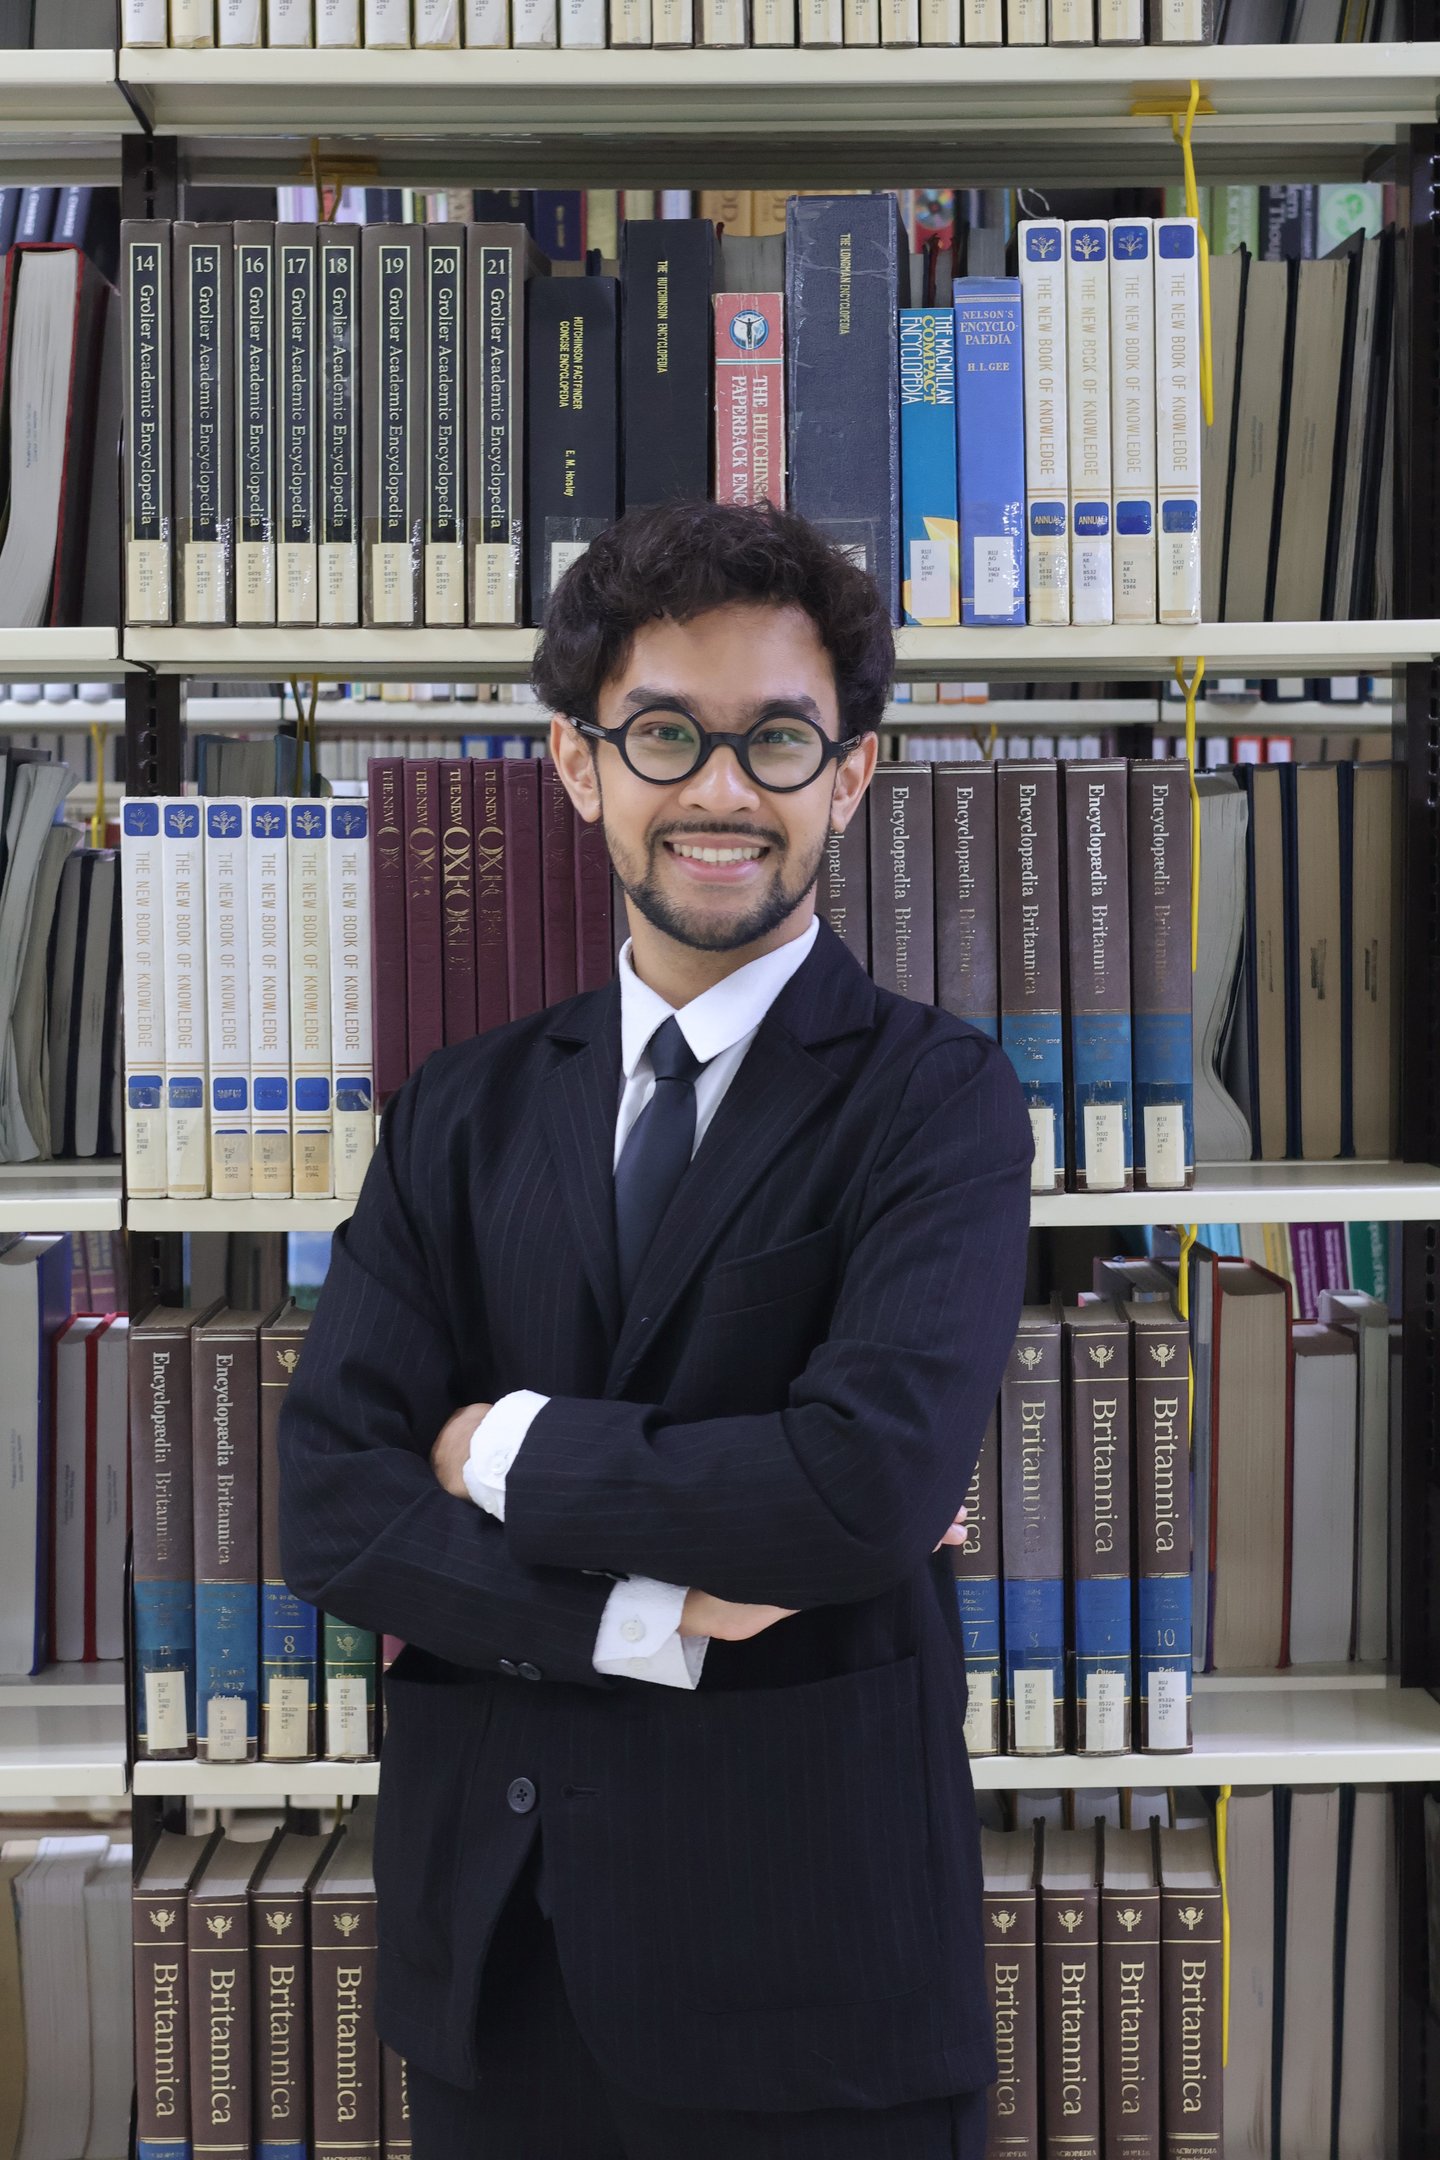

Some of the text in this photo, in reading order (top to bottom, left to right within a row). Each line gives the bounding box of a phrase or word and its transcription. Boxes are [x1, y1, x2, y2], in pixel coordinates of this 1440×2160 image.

[136, 256, 155, 272] 14
[195, 257, 214, 273] 15
[245, 257, 264, 273] 16
[287, 258, 306, 274] 17
[328, 257, 347, 273] 18
[385, 258, 404, 274] 19
[433, 258, 455, 274] 20
[487, 259, 506, 275] 21
[657, 261, 668, 373] THE HUTCHINSON ENCYCLOPEDIA
[839, 233, 851, 335] THE LONGMAN ENCYCLOPEDIA
[962, 310, 1014, 320] NELSON'S
[559, 321, 570, 408] CONCISE ENCYCLOPEDIA
[573, 316, 583, 409] HUTCHINSON FACTFINDER
[900, 317, 923, 405] ENCYCLOPEDIA
[922, 315, 936, 405] COMPACT
[935, 315, 954, 404] THE MACMILLAN
[959, 321, 1019, 333] ENCYCLO-
[965, 333, 1012, 346] PAEDIA
[988, 362, 1010, 372] GEE
[1037, 277, 1055, 475] THE NEW BOOK OF KNOWLEDGE
[1081, 278, 1098, 476] THE NEW BOOK OF KNOWLEDGE
[1125, 277, 1141, 473] THE NEW BOOK OF KNOWLEDGE
[1170, 274, 1187, 471] THE NEW BOOK OF KNOWLEDGE
[138, 285, 156, 525] Grolier Academic Encyclopedia
[196, 286, 214, 526] Grolier Academic Encyclopedia
[246, 286, 264, 527] Grolier Academic Encyclopedia
[289, 288, 306, 528] Grolier Academic Encyclopedia
[330, 287, 347, 527] Grolier Academic Encyclopedia
[386, 287, 404, 528] Grolier Academic Encyclopedia
[435, 288, 452, 527] Grolier Academic Encyclopedia
[487, 289, 505, 528] Grolier Academic Encyclopedia
[732, 376, 747, 506] PAPERBACK ENC
[753, 376, 767, 407] THE
[563, 470, 576, 497] Horsley
[565, 459, 576, 469] M.
[382, 770, 393, 795] THE
[416, 770, 428, 824] THE NEW
[450, 769, 461, 798] THE
[450, 798, 461, 824] NEW
[485, 798, 496, 825] NEW
[890, 787, 910, 899] Encyclopædia
[956, 787, 974, 899] Encyclopædia
[1018, 784, 1040, 995] Encyclopædia Britannica
[1087, 783, 1107, 897] Encyclopædia
[1150, 784, 1170, 896] Encyclopædia
[136, 852, 152, 1047] THE NEW BOOK OF KNOWLEDGE
[176, 854, 192, 1049] THE NEW BOOK OF KNOWLEDGE
[218, 854, 236, 1050] THE NEW BOOK OF KNOWLEDGE
[261, 854, 276, 1050] THE NEW BOOK OF KNOWLEDGE
[302, 854, 318, 1050] THE NEW BOOK OF KNOWLEDGE
[342, 854, 358, 1050] THE NEW BOOK OF KNOWLEDGE
[150, 1351, 170, 1464] Encyclopædia
[213, 1353, 234, 1565] Encyclopædia Britannica
[1092, 1398, 1117, 1554] Britannica
[1153, 1397, 1179, 1553] Britannica
[284, 1635, 295, 1654] 8
[968, 1631, 979, 1650] 7
[1157, 1628, 1176, 1647] 10
[154, 1963, 179, 2117] Britannica
[210, 1968, 236, 2125] Britannica
[270, 1964, 295, 2119] Britannica
[337, 1966, 362, 2123] Britannica
[995, 1963, 1020, 2116] Britannica
[1061, 1962, 1086, 2116] Britannica
[1120, 1961, 1145, 2114] Britannica
[1181, 1959, 1207, 2113] Britannica
